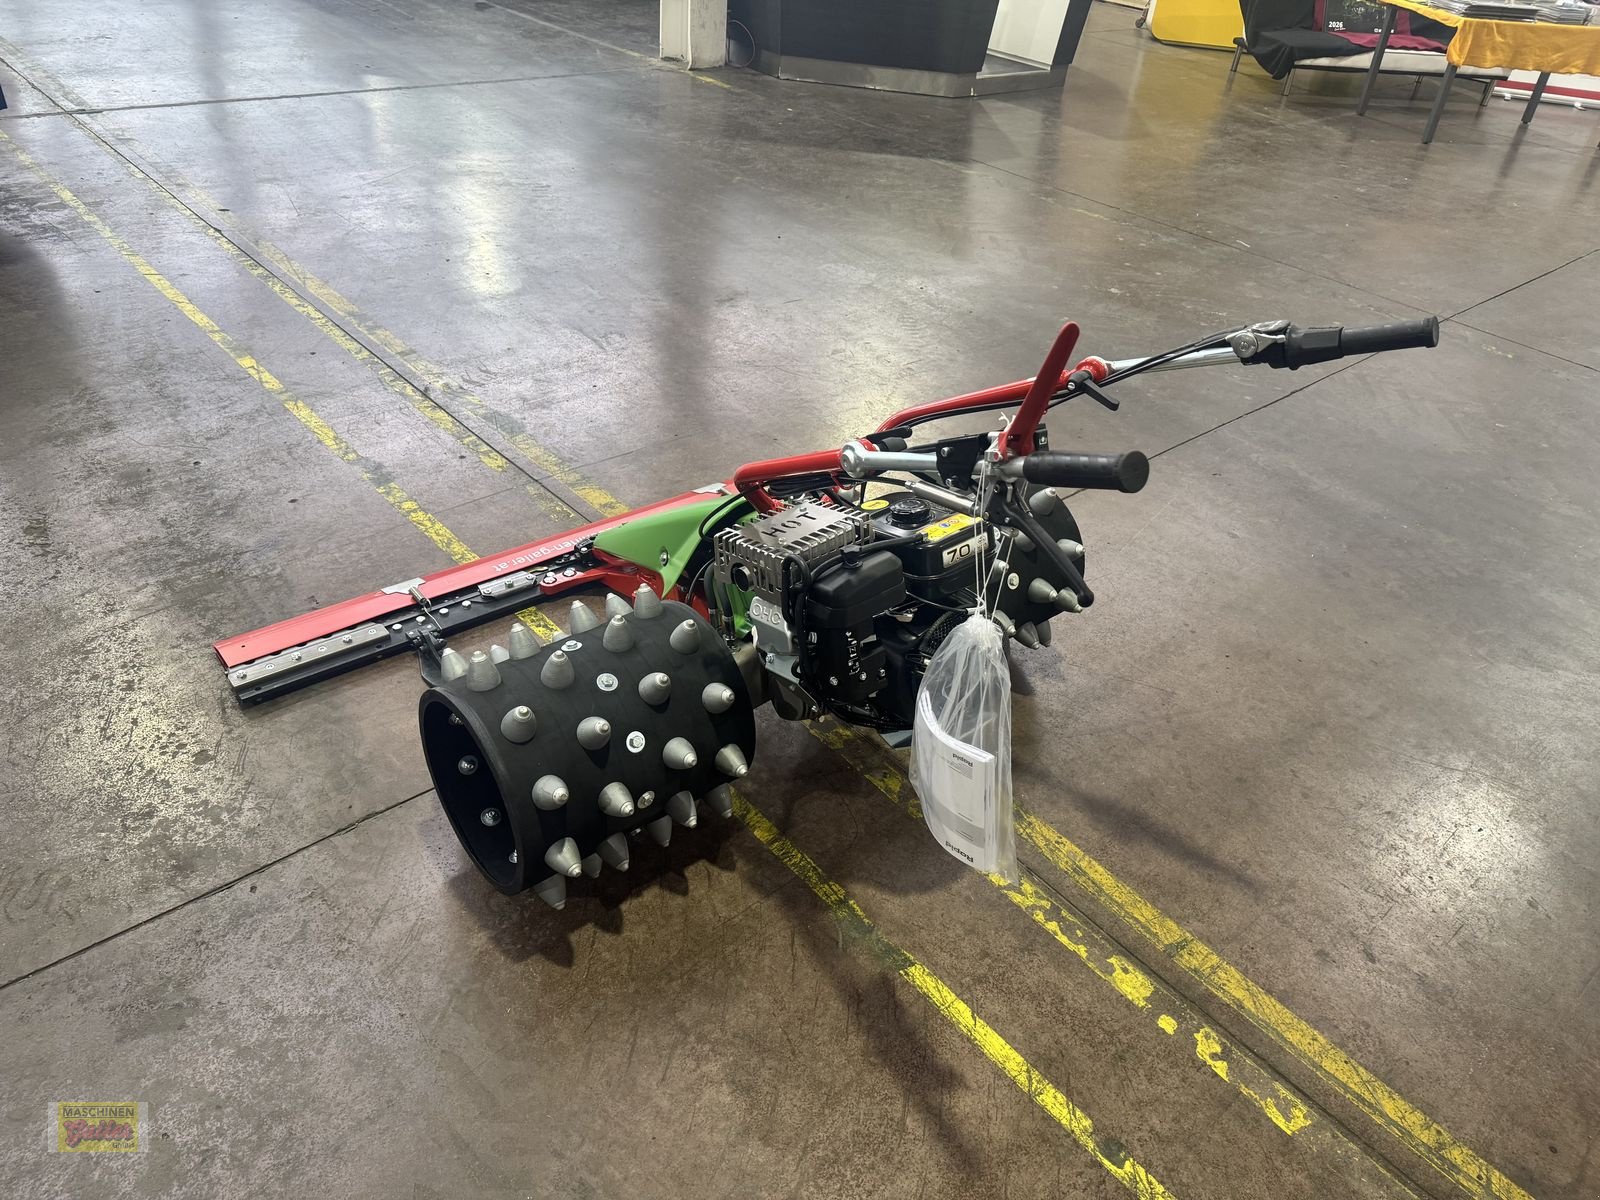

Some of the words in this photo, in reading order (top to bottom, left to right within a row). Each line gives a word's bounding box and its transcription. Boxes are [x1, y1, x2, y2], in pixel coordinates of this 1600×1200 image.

[761, 511, 817, 538] HOT
[946, 543, 971, 563] 7.0
[752, 602, 781, 625] OHC
[952, 753, 973, 768] Rapid
[945, 840, 974, 863] Rapid
